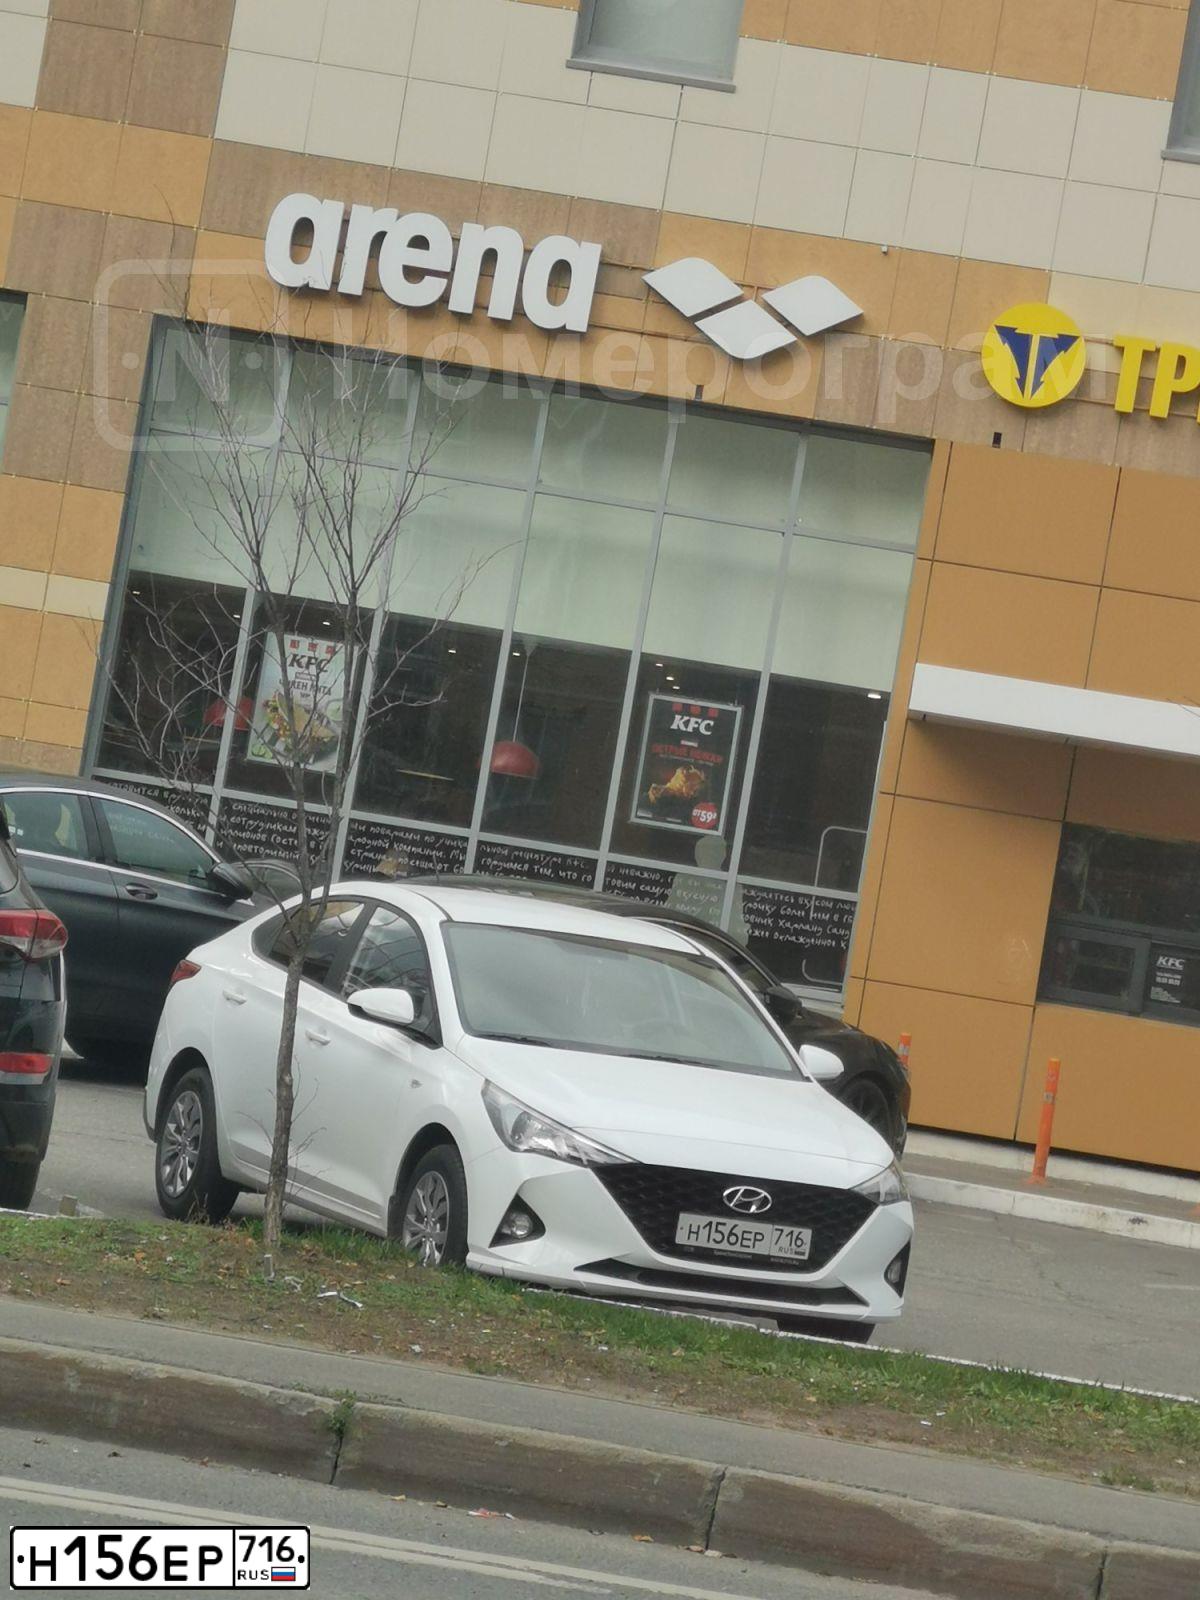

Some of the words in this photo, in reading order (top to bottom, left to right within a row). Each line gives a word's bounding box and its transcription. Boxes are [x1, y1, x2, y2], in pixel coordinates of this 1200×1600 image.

[264, 192, 603, 333] arena
[1114, 334, 1200, 424] ТР
[288, 653, 330, 672] KFC
[670, 713, 715, 735] KFC
[1156, 955, 1186, 970] KFC
[686, 1220, 766, 1250] Н156ЕР
[774, 1227, 805, 1248] 716
